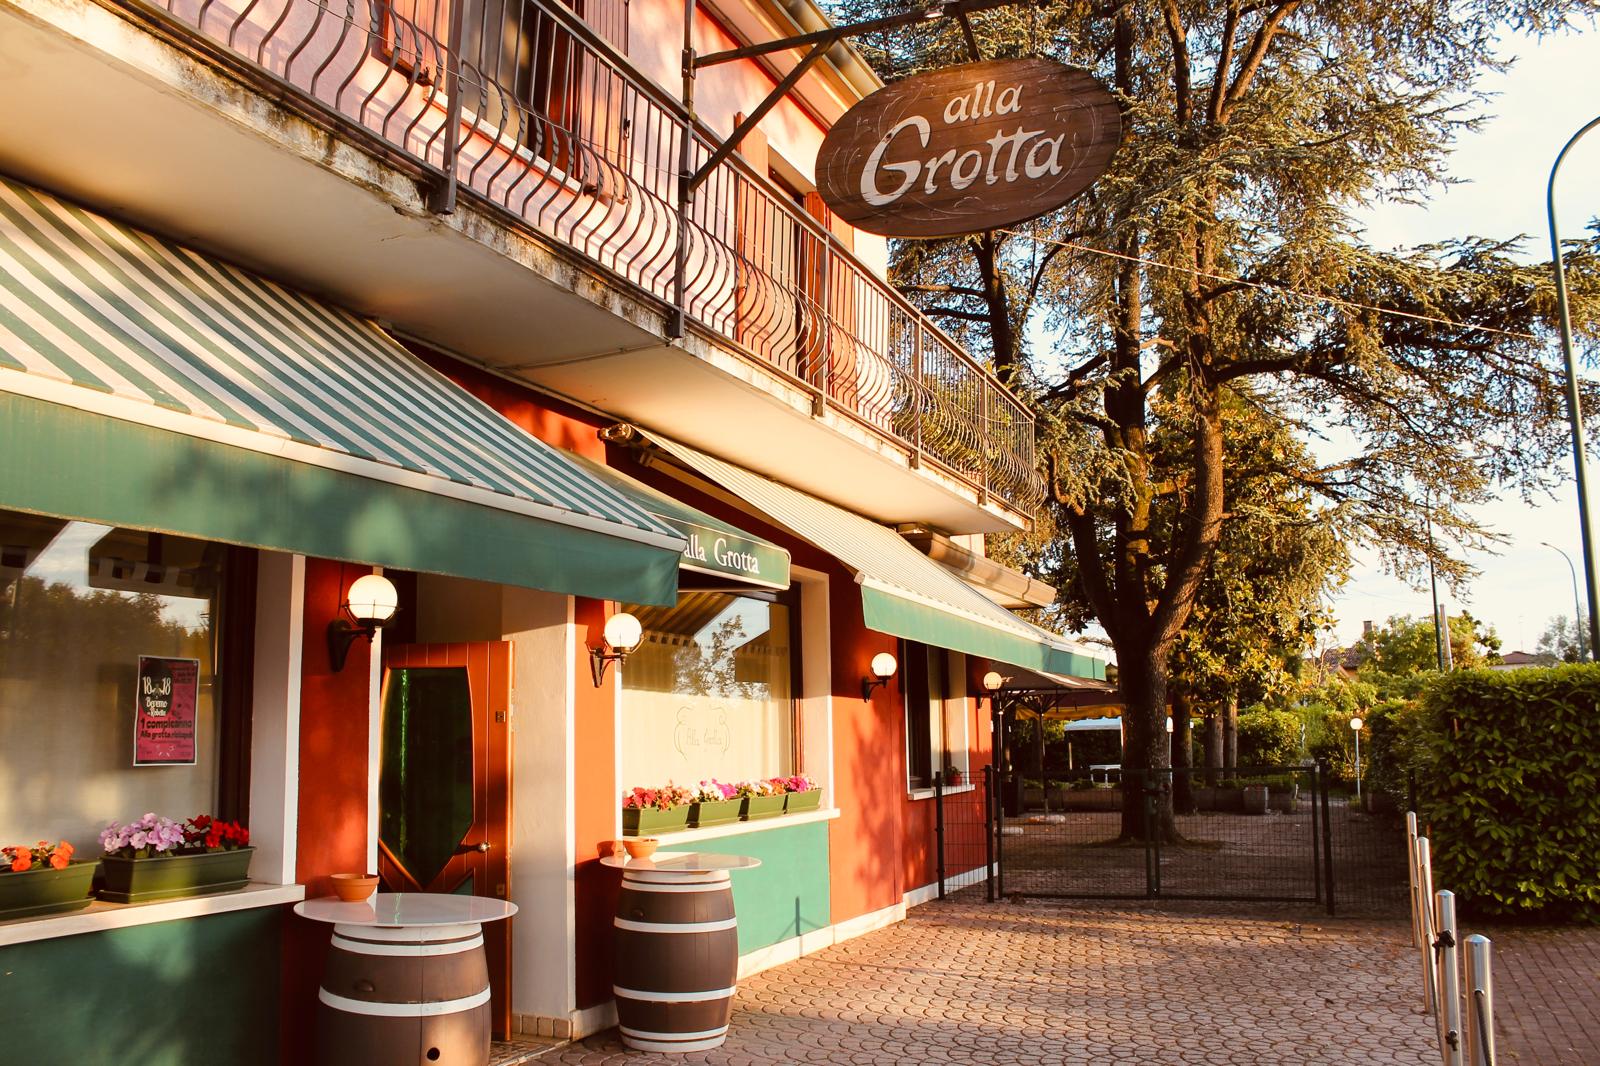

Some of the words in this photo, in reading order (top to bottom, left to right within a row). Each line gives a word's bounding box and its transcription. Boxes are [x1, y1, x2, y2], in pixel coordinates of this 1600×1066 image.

[943, 80, 1024, 124] alla
[860, 115, 1066, 206] Grotta
[683, 534, 707, 562] alla
[714, 538, 760, 574] Grotta
